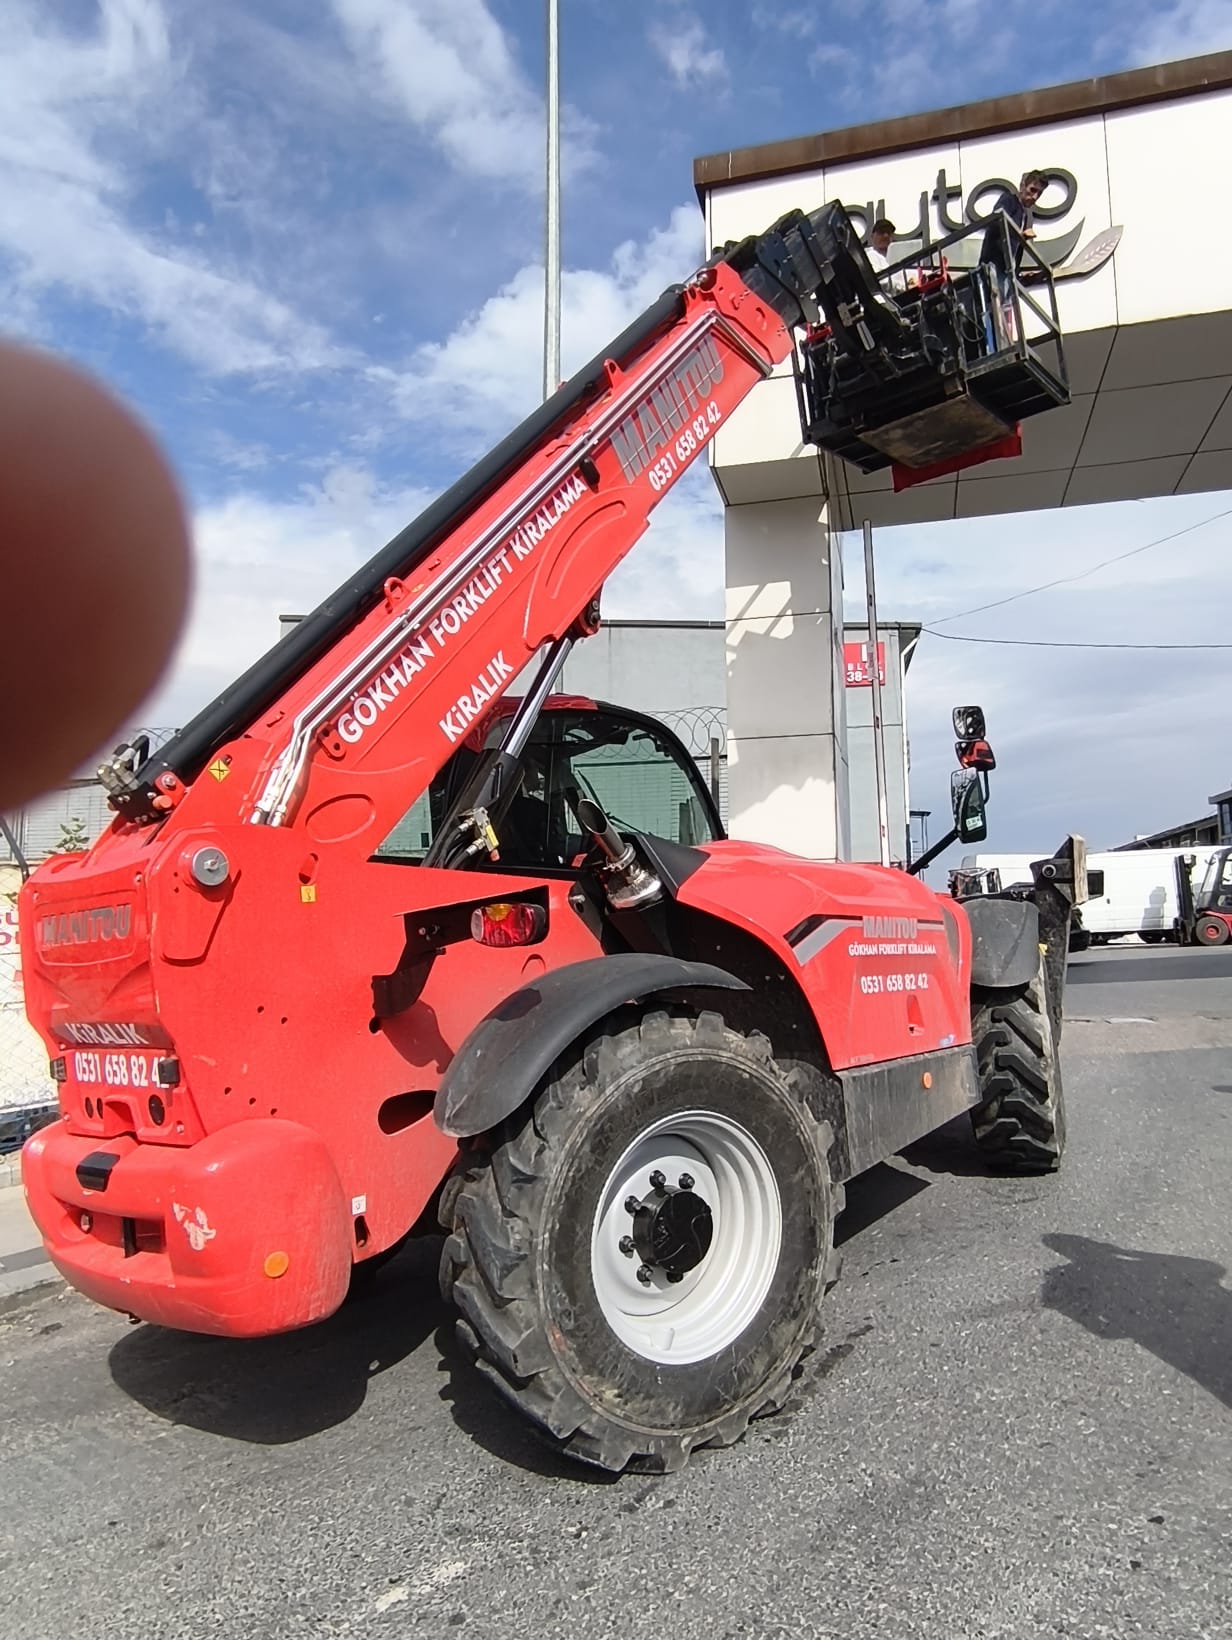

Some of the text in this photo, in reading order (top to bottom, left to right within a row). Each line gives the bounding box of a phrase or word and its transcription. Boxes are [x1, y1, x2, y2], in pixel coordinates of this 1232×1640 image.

[609, 332, 724, 484] MANITOU
[648, 401, 721, 491] 0531 658 82 42
[337, 474, 587, 743] GÖKHAN FORKLİFT KİRALAMA
[41, 904, 131, 949] MANITOU
[863, 916, 918, 939] MANITOU
[848, 941, 878, 956] GÖKHAN
[861, 972, 929, 994] 0531 658 82 42
[75, 1052, 102, 1082] 0531
[105, 1054, 128, 1086] 658
[130, 1055, 148, 1087] 82
